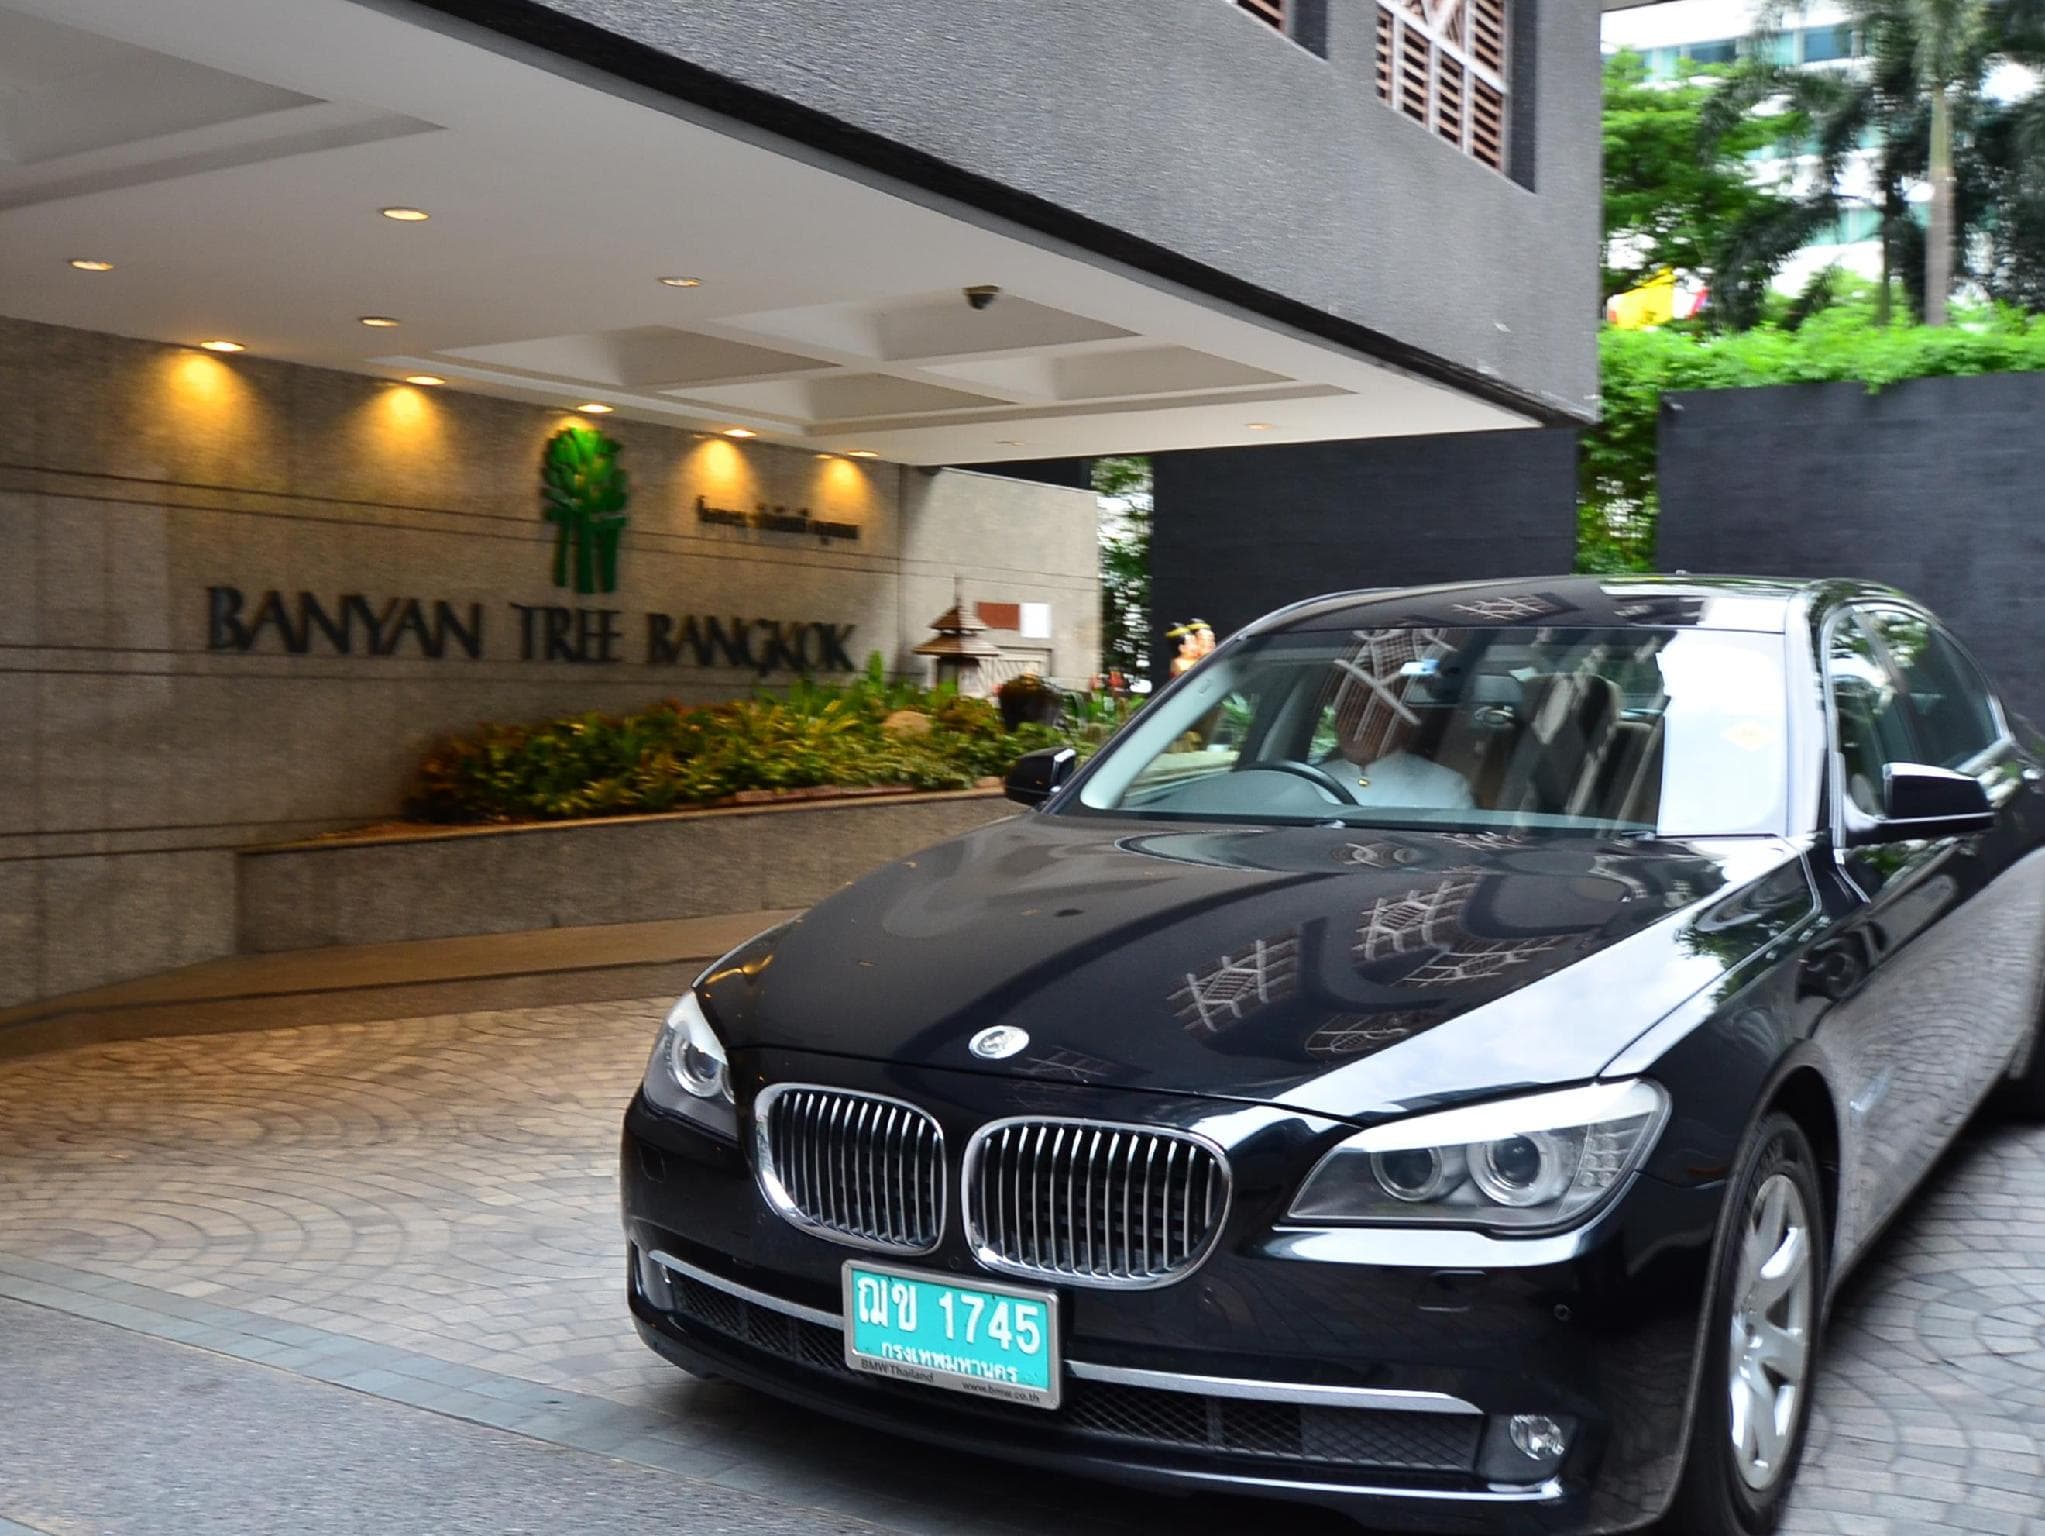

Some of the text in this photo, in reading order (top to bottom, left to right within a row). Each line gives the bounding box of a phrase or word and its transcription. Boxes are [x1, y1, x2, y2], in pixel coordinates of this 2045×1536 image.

[205, 586, 856, 677] BANYAN TREE BANGKOK
[938, 1290, 1042, 1355] 1745
[860, 1359, 890, 1376] BMW
[890, 1365, 935, 1383] Thailand
[880, 1341, 1018, 1383] กรงเทพมหานคร
